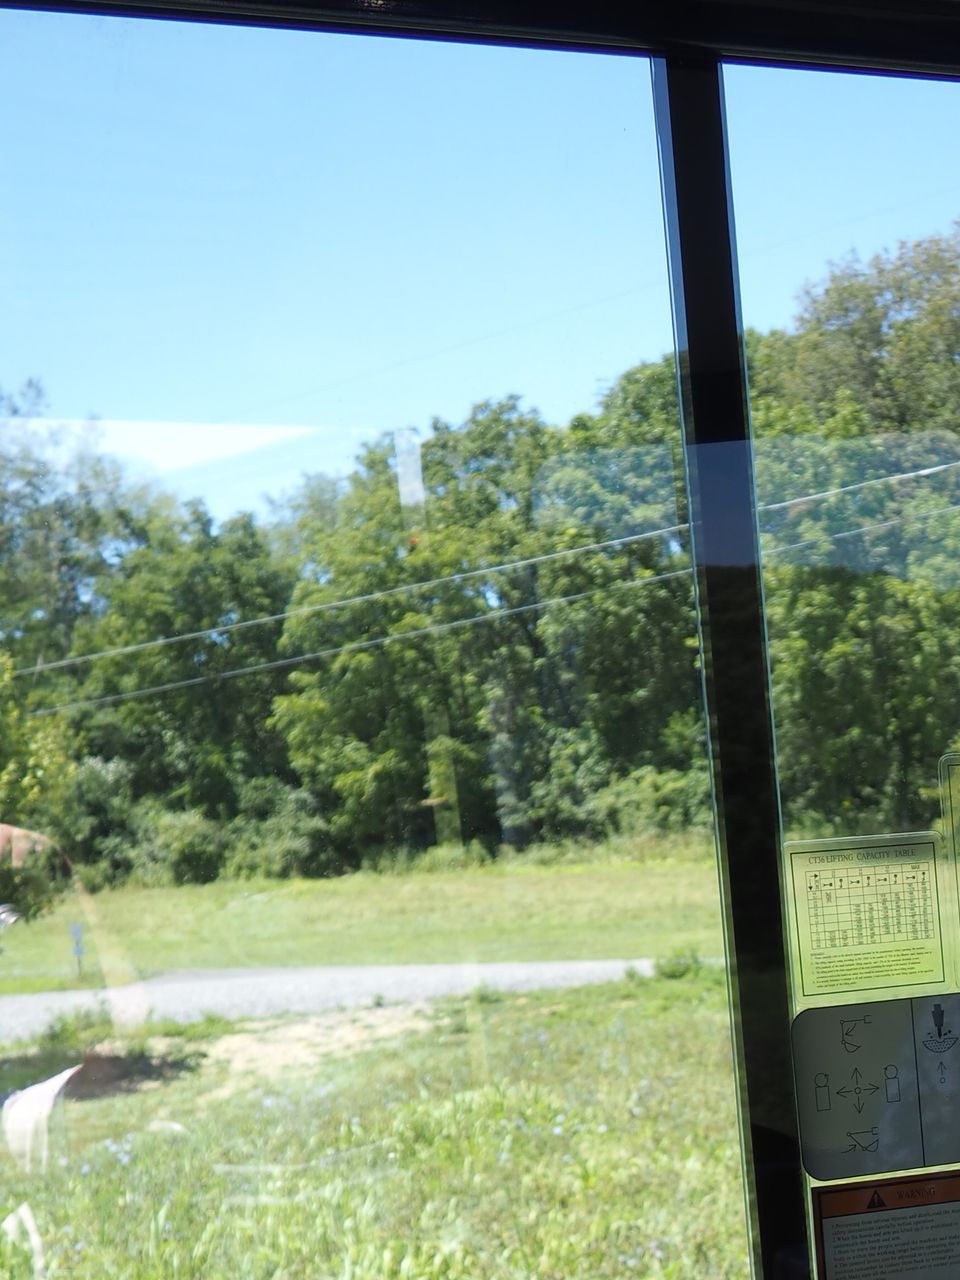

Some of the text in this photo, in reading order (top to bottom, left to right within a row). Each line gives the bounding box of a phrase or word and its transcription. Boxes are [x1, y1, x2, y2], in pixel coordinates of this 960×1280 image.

[809, 848, 916, 864] CT36 LIFTING CAPACITY TABLE
[896, 1188, 935, 1199] WARNING
